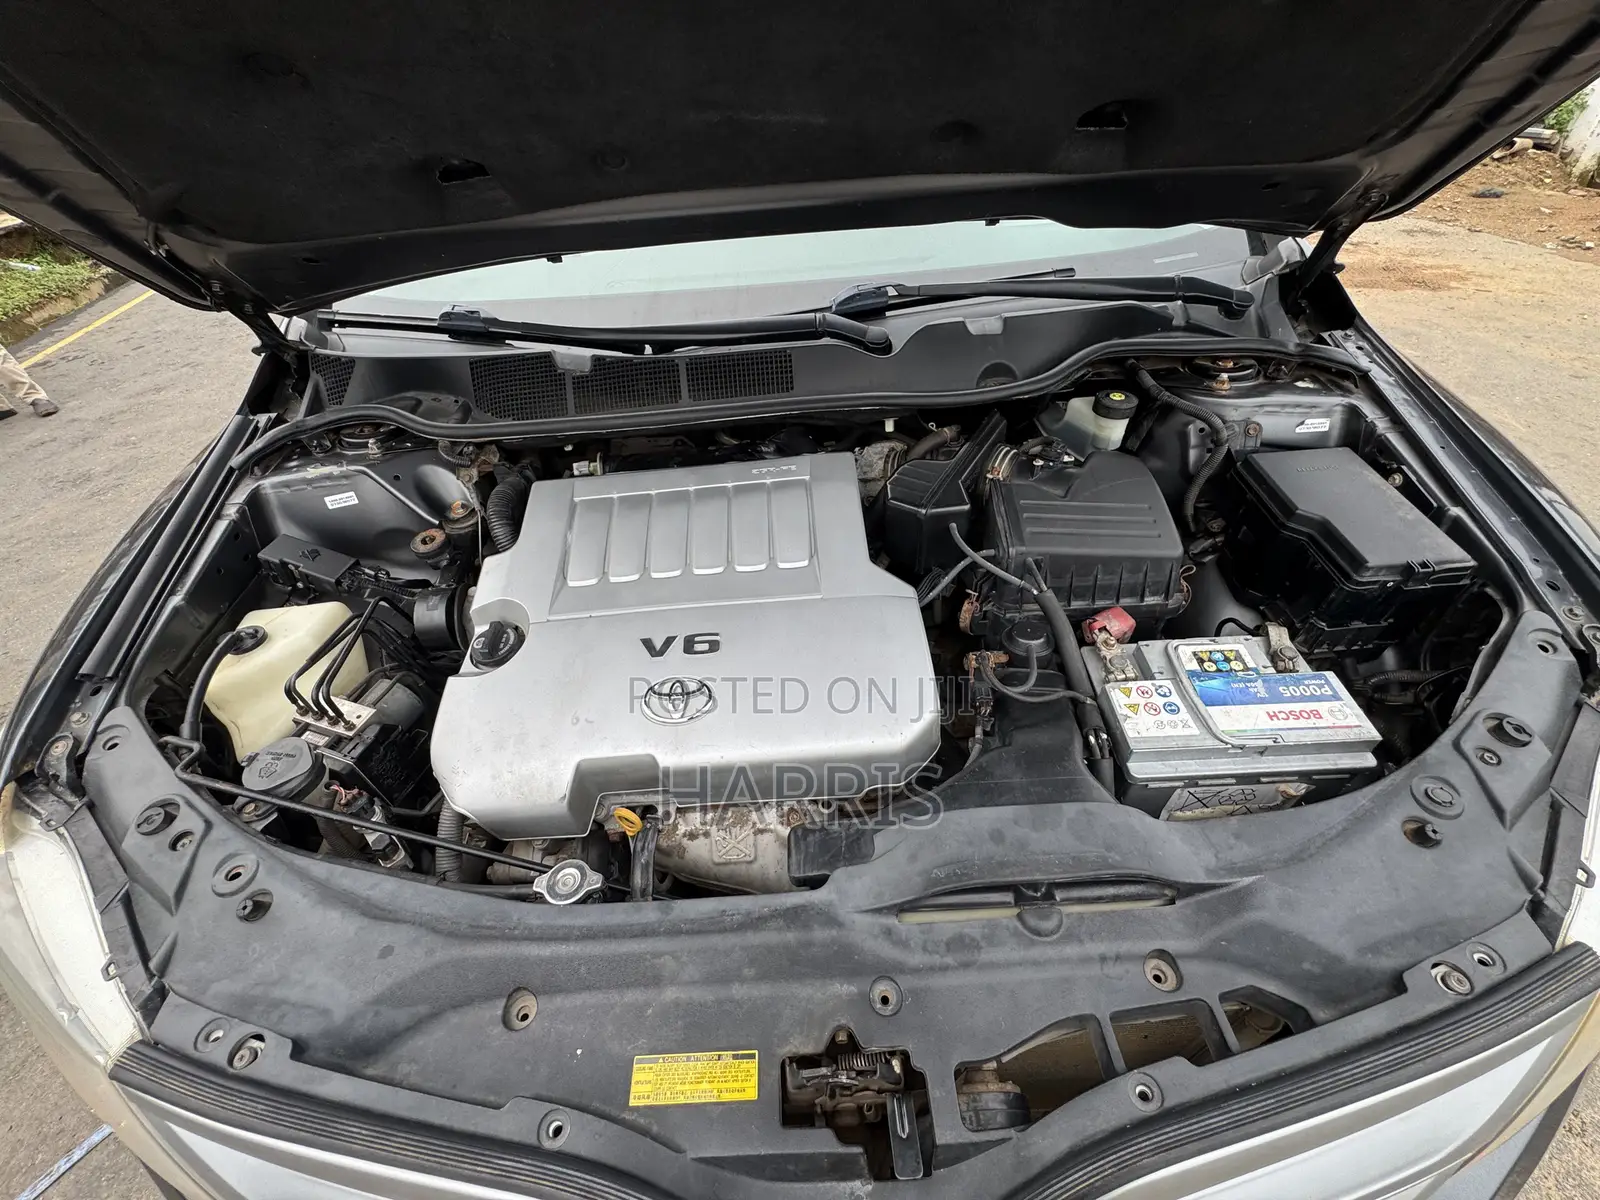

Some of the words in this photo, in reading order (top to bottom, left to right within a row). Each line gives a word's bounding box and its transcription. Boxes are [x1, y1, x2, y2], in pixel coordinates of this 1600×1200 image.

[639, 632, 720, 659] V6
[1278, 684, 1333, 697] P0005
[1265, 709, 1324, 721] BOSCH
[663, 1056, 687, 1064] CAUTION
[690, 1054, 719, 1062] ATTENTION
